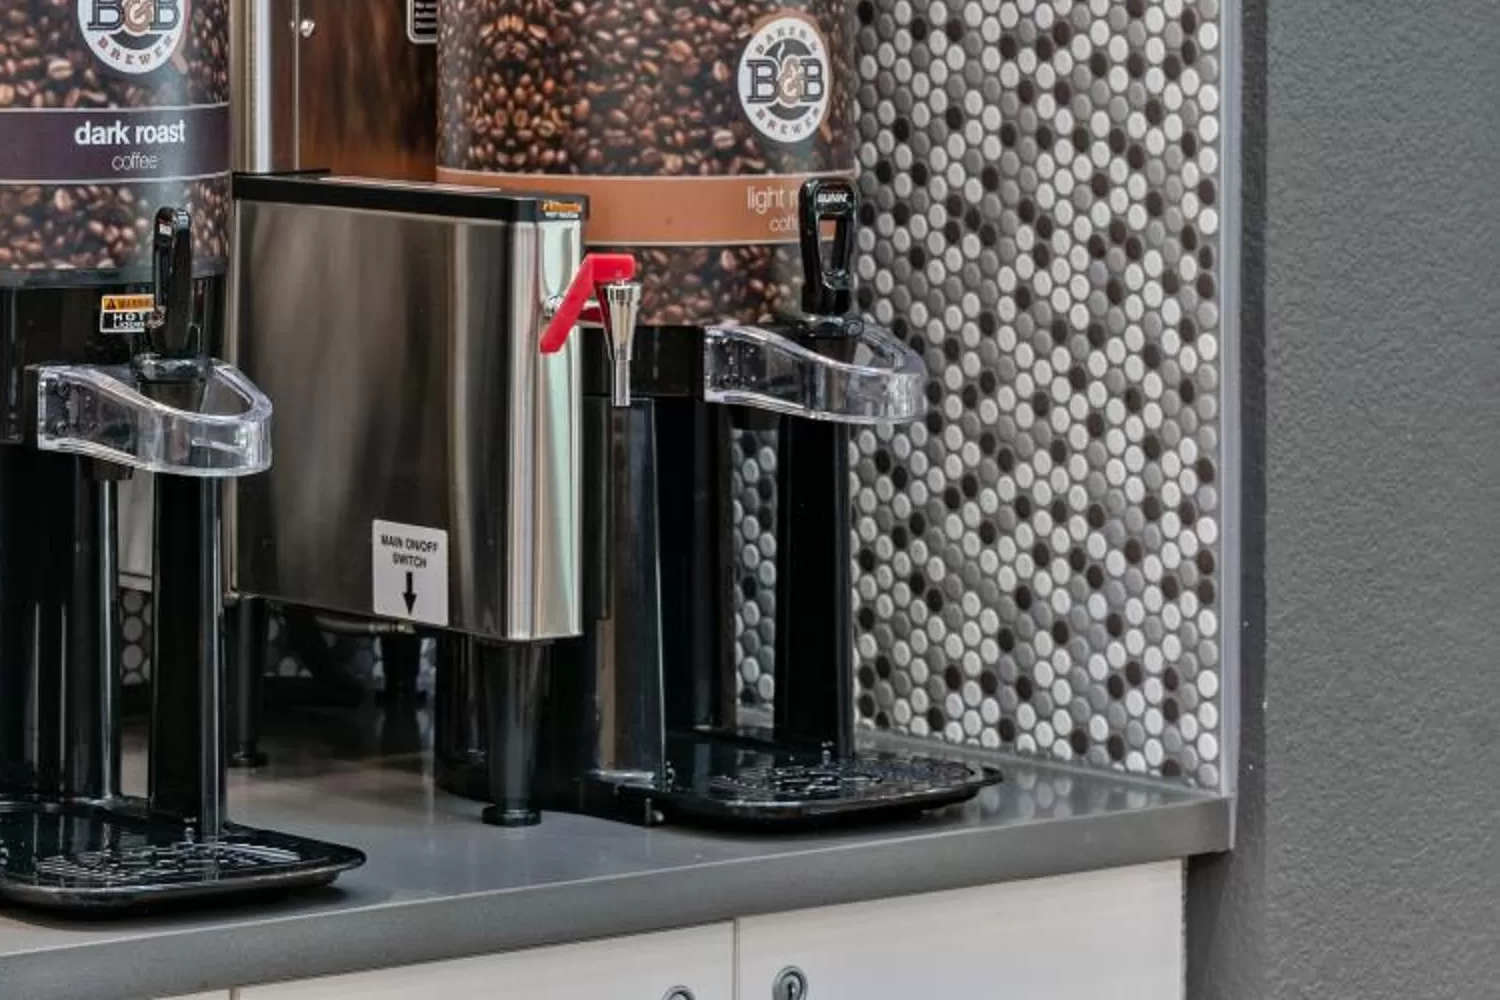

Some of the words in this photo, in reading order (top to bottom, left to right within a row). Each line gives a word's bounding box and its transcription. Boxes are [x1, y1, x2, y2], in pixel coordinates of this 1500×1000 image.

[74, 120, 130, 145] dark
[135, 119, 185, 144] roast
[111, 152, 159, 171] coffee
[747, 185, 785, 214] light
